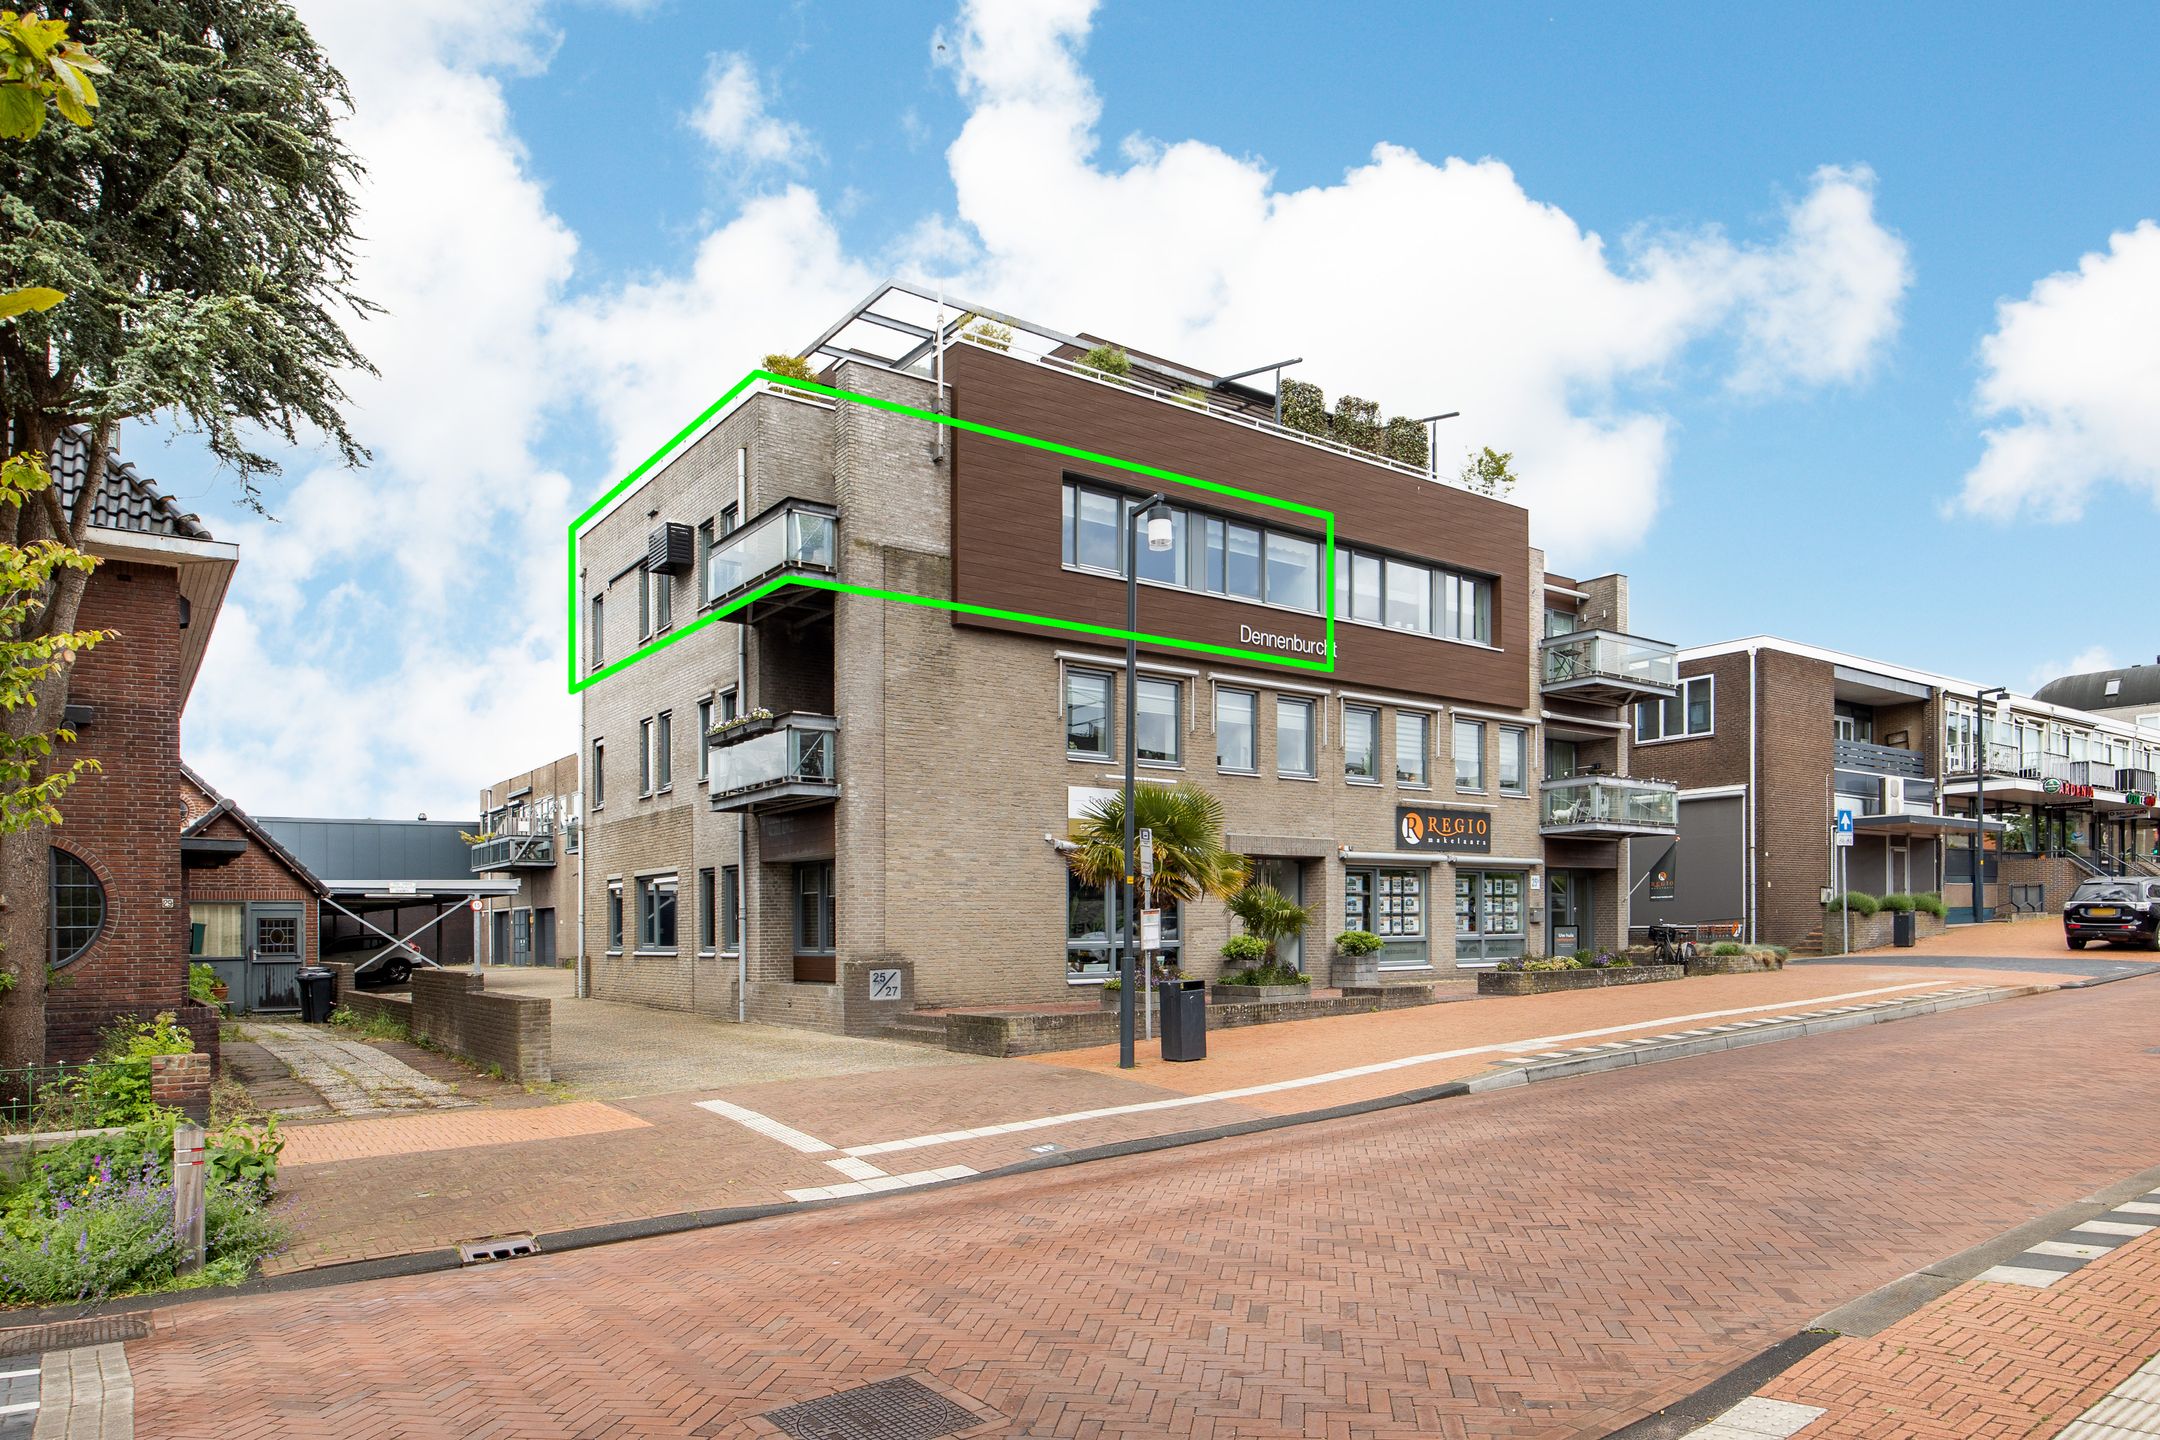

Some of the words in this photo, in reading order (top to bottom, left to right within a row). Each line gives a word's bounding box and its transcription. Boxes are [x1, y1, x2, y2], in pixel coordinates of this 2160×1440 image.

[1240, 624, 1338, 658] Dennenburct
[1427, 816, 1487, 836] REGIO
[1427, 837, 1487, 846] makelaars
[162, 899, 173, 908] 29
[872, 972, 886, 983] 25
[885, 986, 898, 996] 27
